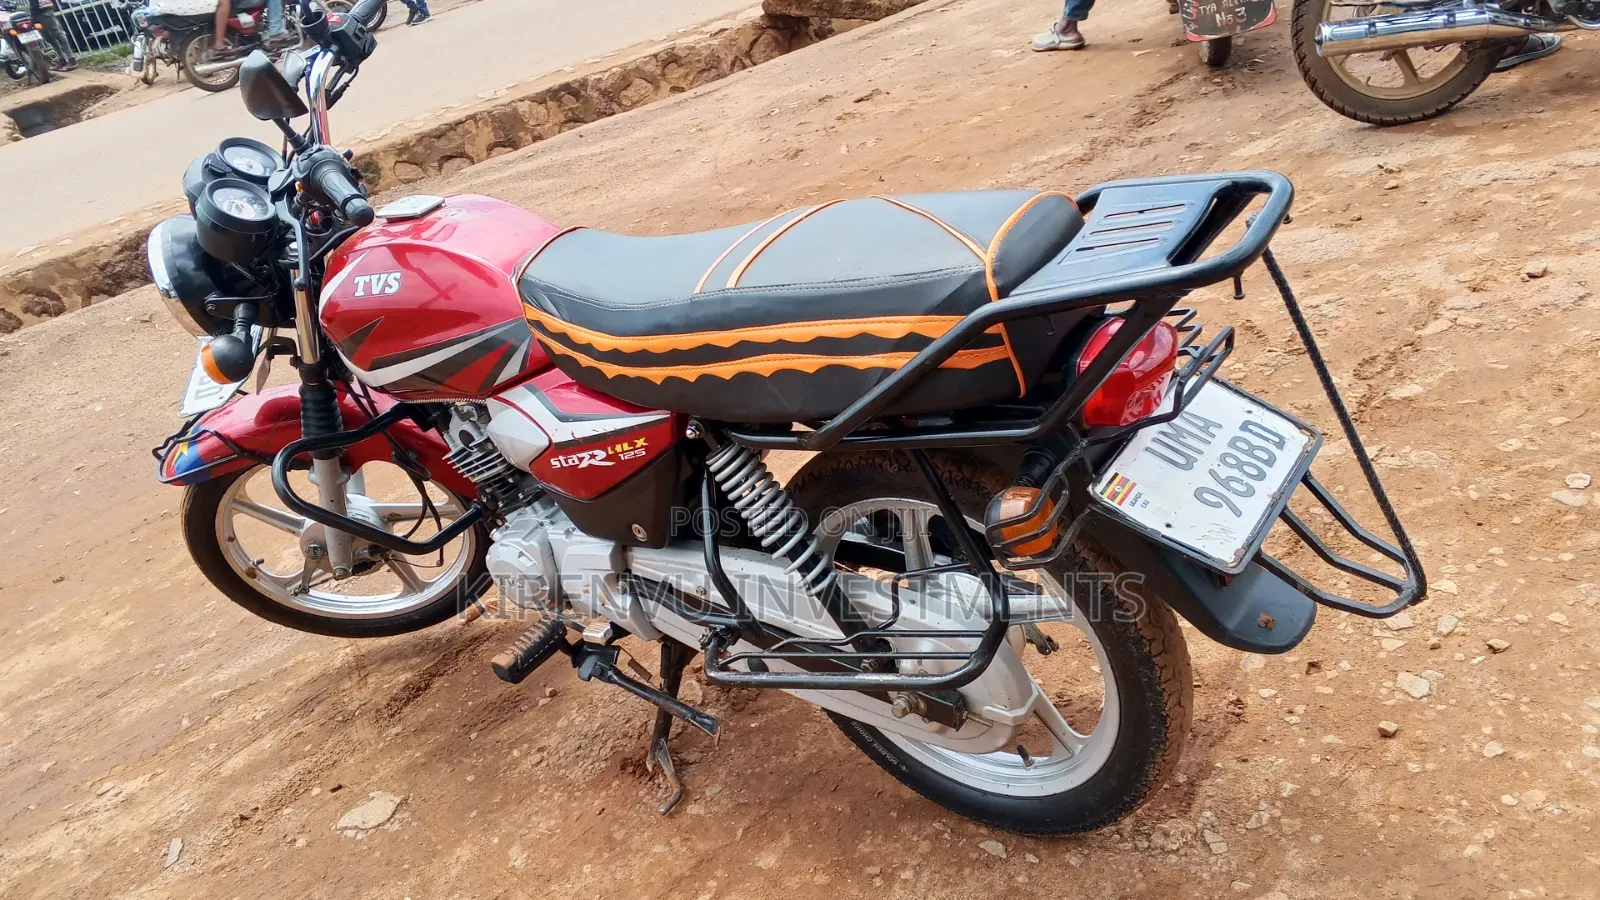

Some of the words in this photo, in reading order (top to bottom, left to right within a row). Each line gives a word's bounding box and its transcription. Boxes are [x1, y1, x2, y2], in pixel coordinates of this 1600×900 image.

[353, 272, 402, 297] TVS
[1144, 411, 1223, 471] UMA
[618, 448, 647, 461] 125
[1193, 419, 1287, 518] 968BD
[851, 721, 872, 742] CHOICE
[873, 743, 898, 765] GOLDEN
